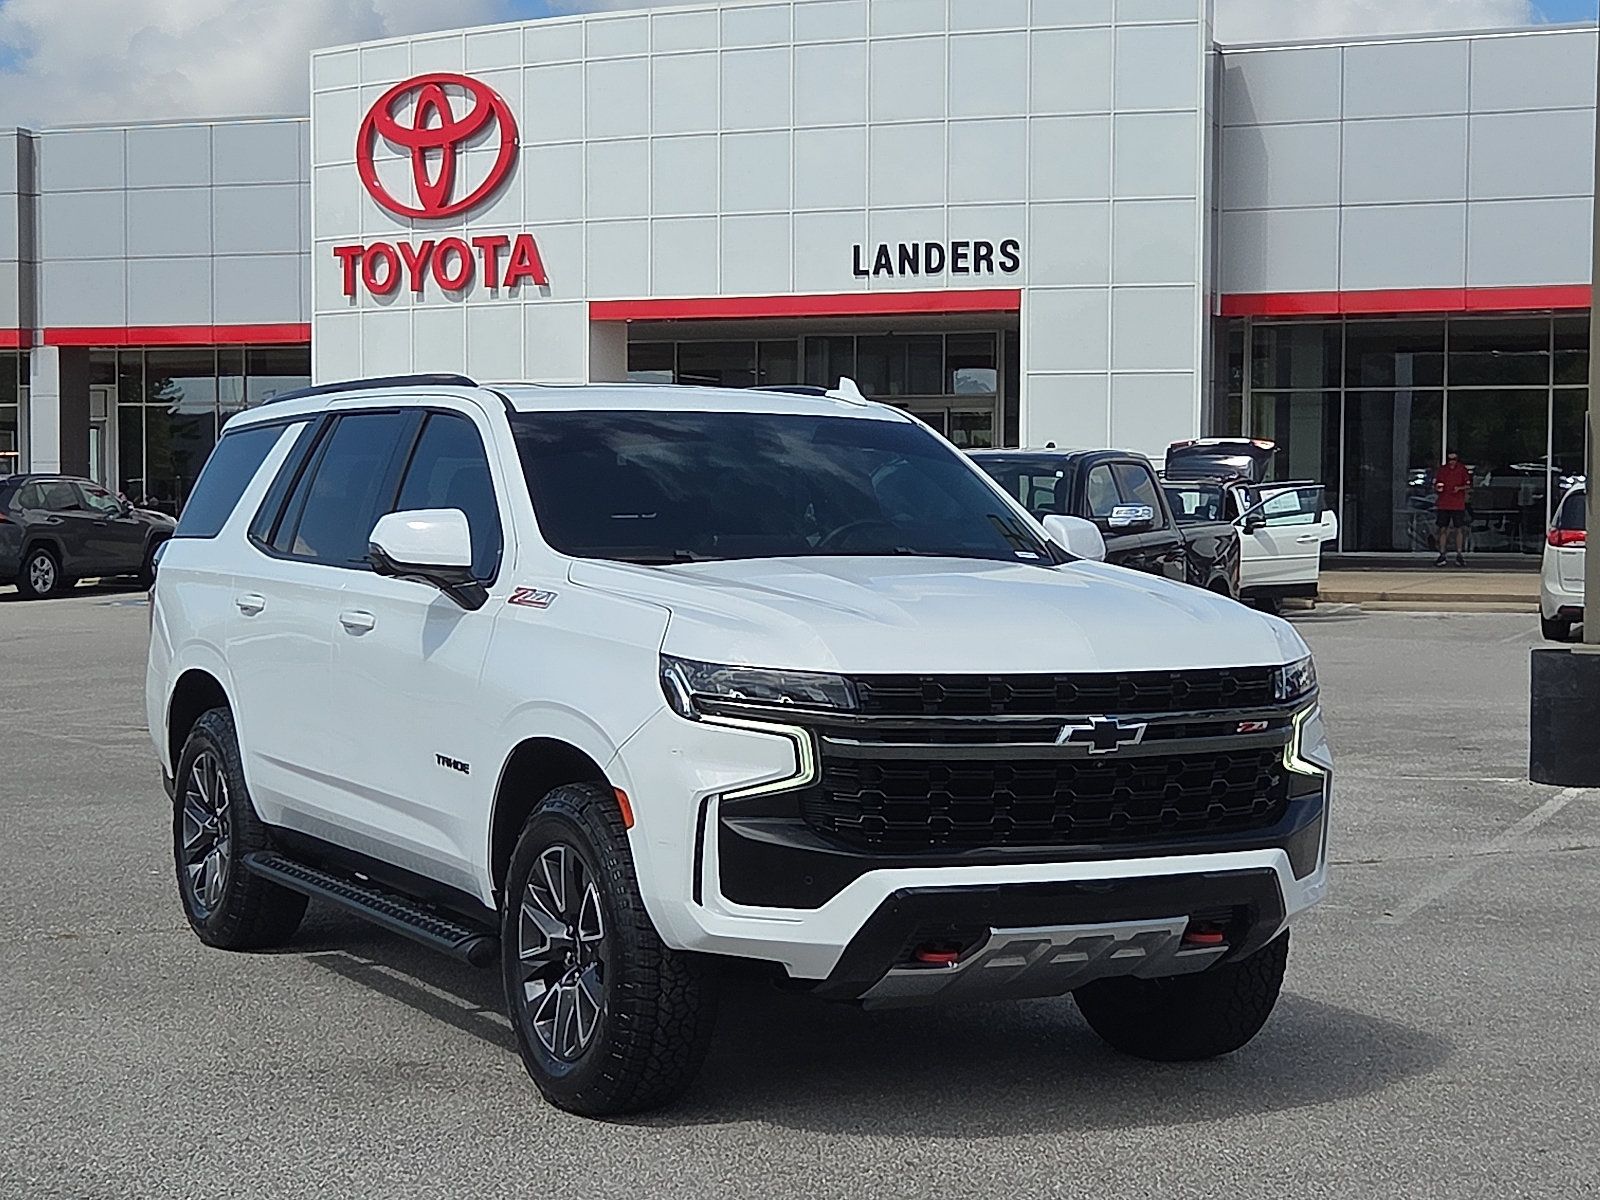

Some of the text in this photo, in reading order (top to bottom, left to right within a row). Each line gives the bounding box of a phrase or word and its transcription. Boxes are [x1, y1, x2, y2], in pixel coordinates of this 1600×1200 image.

[334, 233, 549, 296] TOYOTA
[853, 239, 1020, 276] LANDERS
[508, 586, 558, 609] Z71
[435, 753, 470, 775] TAHOE
